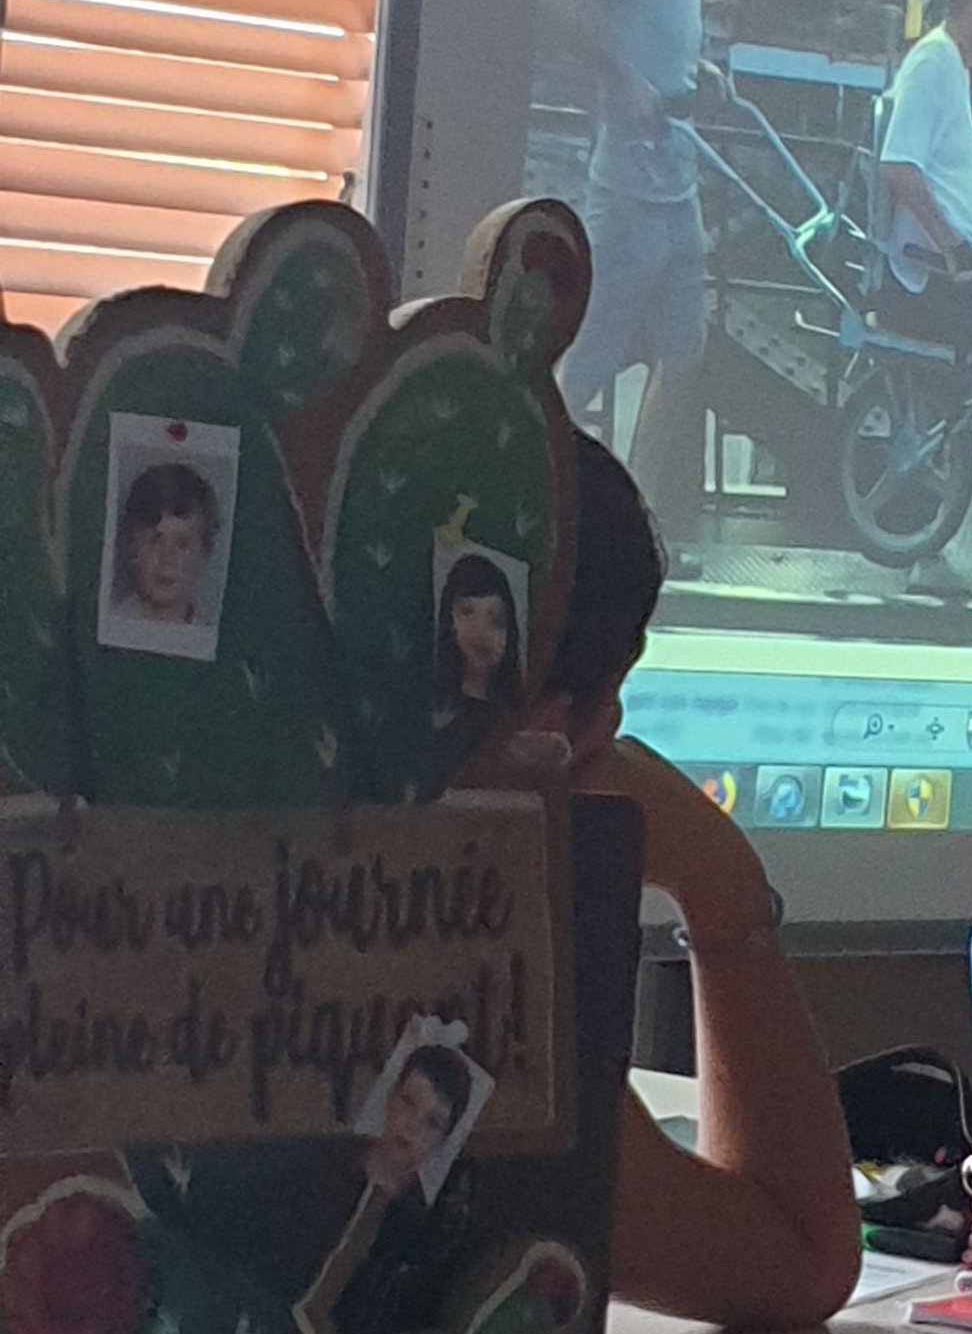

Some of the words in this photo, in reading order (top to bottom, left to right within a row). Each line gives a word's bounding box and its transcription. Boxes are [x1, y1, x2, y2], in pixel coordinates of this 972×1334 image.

[9, 849, 157, 972] Pour
[165, 878, 263, 955] une
[263, 836, 515, 998] journée
[168, 971, 239, 1084] de
